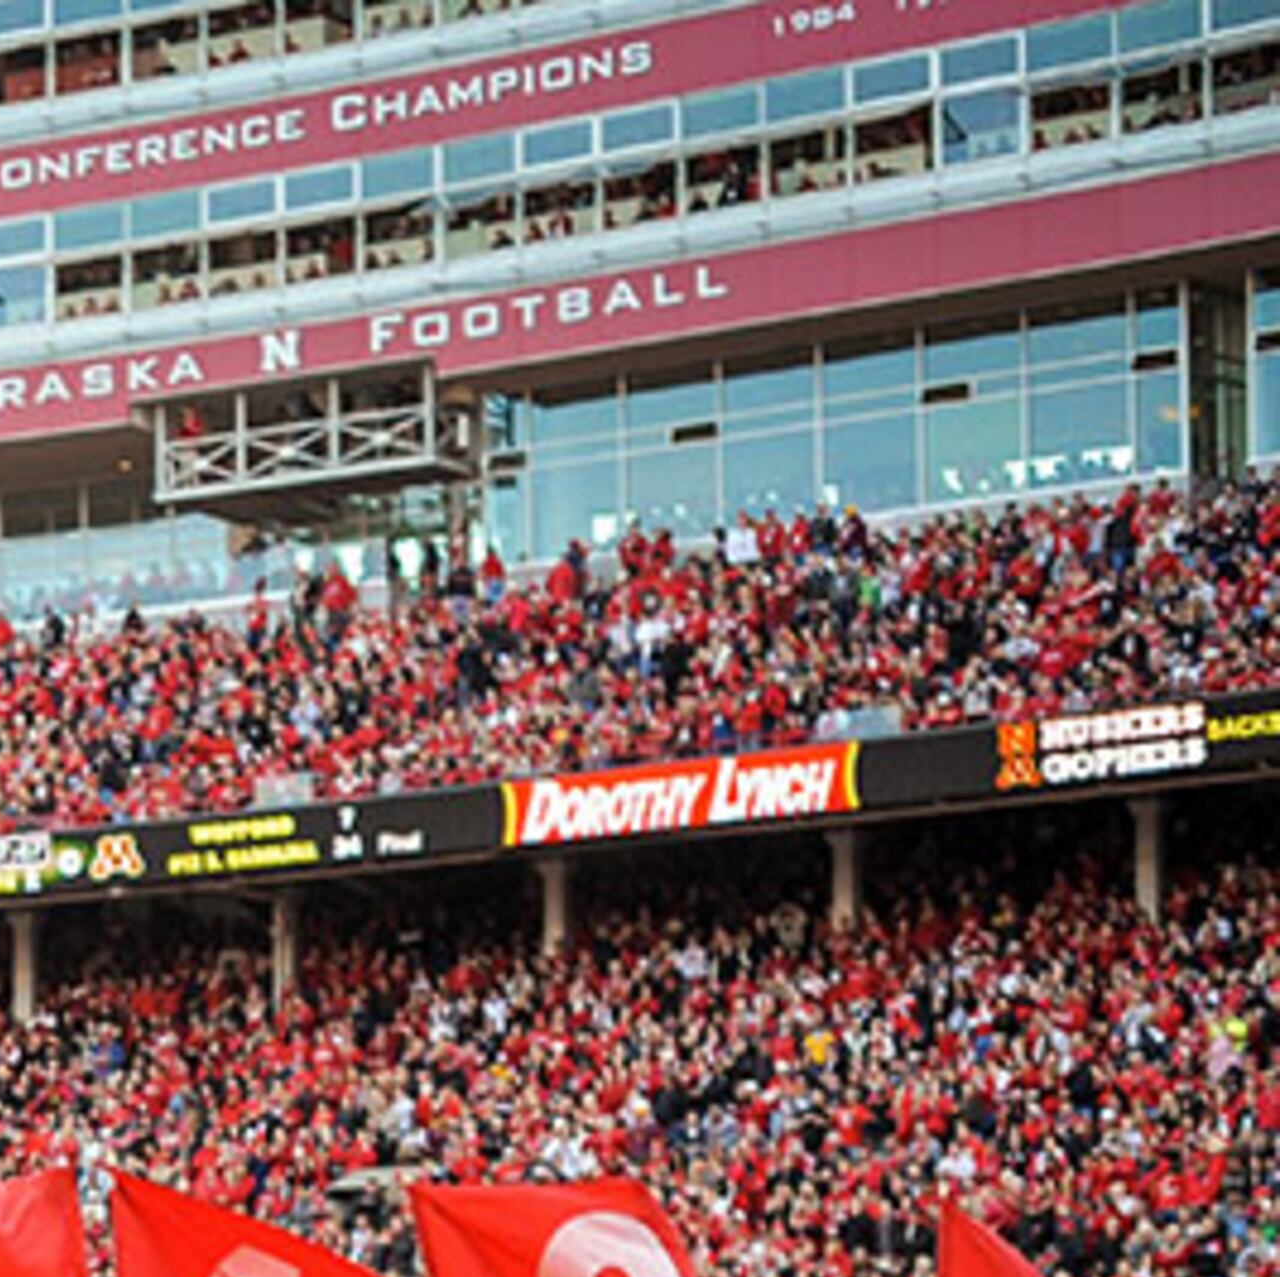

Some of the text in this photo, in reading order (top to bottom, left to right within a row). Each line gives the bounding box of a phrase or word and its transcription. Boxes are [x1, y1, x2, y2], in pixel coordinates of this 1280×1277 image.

[330, 40, 655, 133] CHAMPIONS
[259, 330, 302, 374] N
[369, 265, 731, 356] FOOTBALL
[519, 755, 838, 845] DOROTHY LYNCH
